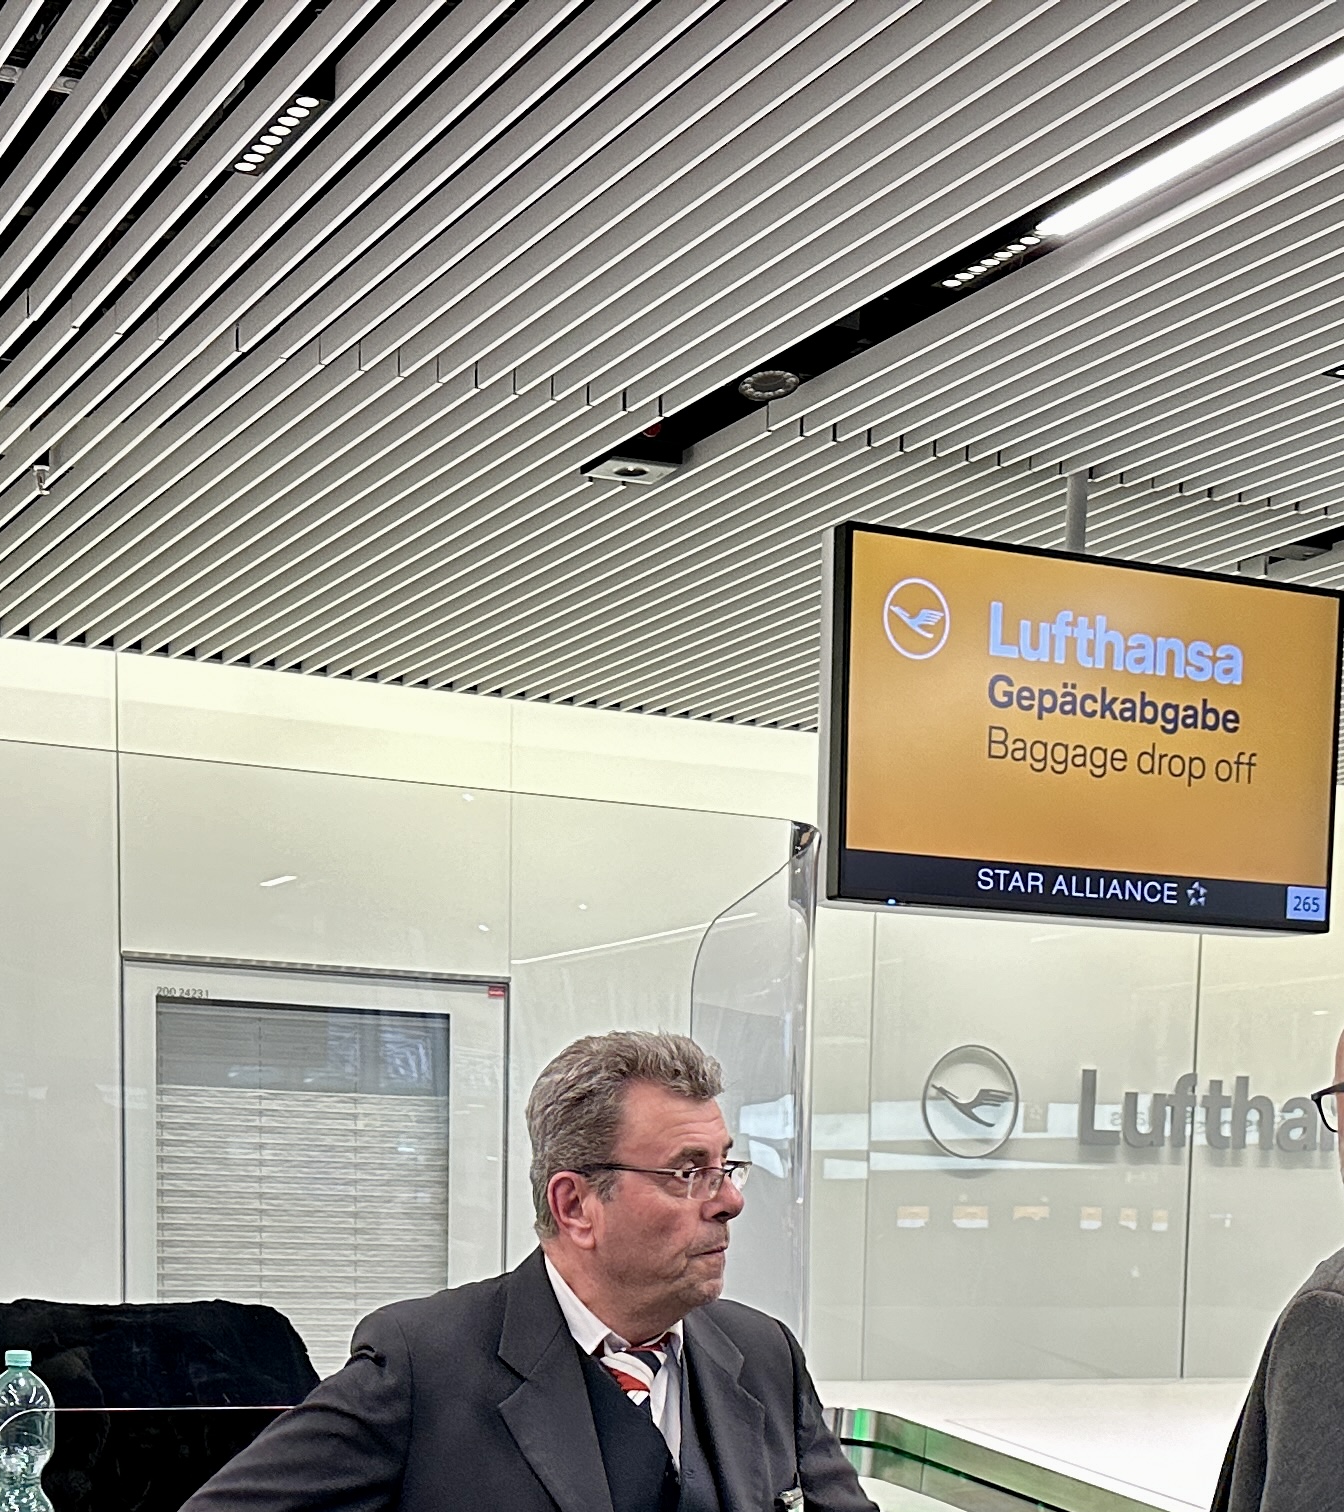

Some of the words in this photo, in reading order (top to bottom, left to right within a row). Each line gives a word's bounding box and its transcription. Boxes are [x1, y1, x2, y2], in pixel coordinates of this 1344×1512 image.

[987, 600, 1244, 686] Lufthansa
[987, 673, 1241, 735] Gepäckabgabe
[986, 726, 1128, 778] Baggage
[1137, 742, 1206, 787] drop
[1214, 752, 1258, 785] off
[976, 867, 1045, 895] STAR
[1051, 873, 1179, 905] ALLIANCE
[1292, 894, 1321, 914] 265
